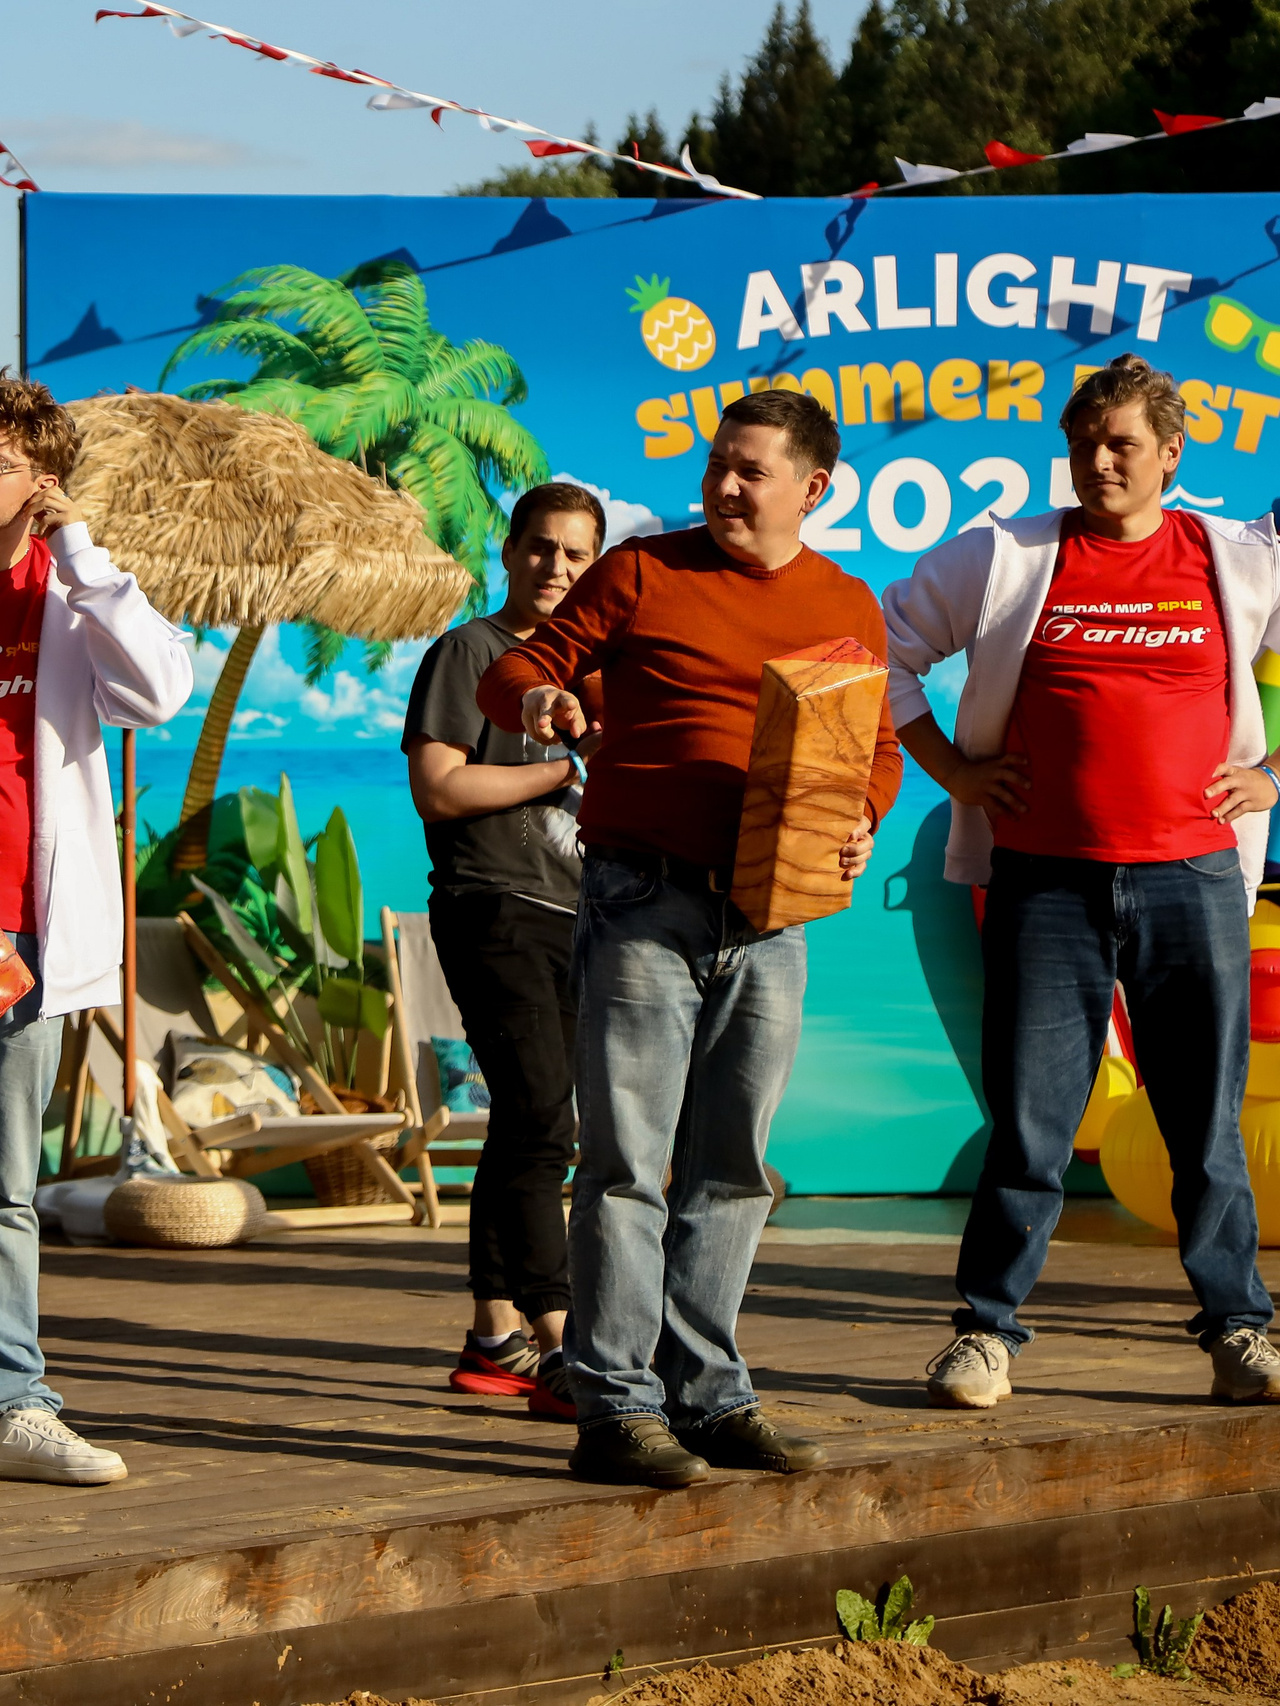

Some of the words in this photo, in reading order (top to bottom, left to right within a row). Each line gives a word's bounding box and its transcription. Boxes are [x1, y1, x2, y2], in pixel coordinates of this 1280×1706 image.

[737, 252, 1192, 350] ARLIGHT
[1073, 364, 1280, 454] ST
[1115, 602, 1154, 614] МИР
[1157, 600, 1203, 611] ЯРЧЕ
[1082, 626, 1207, 648] arlight
